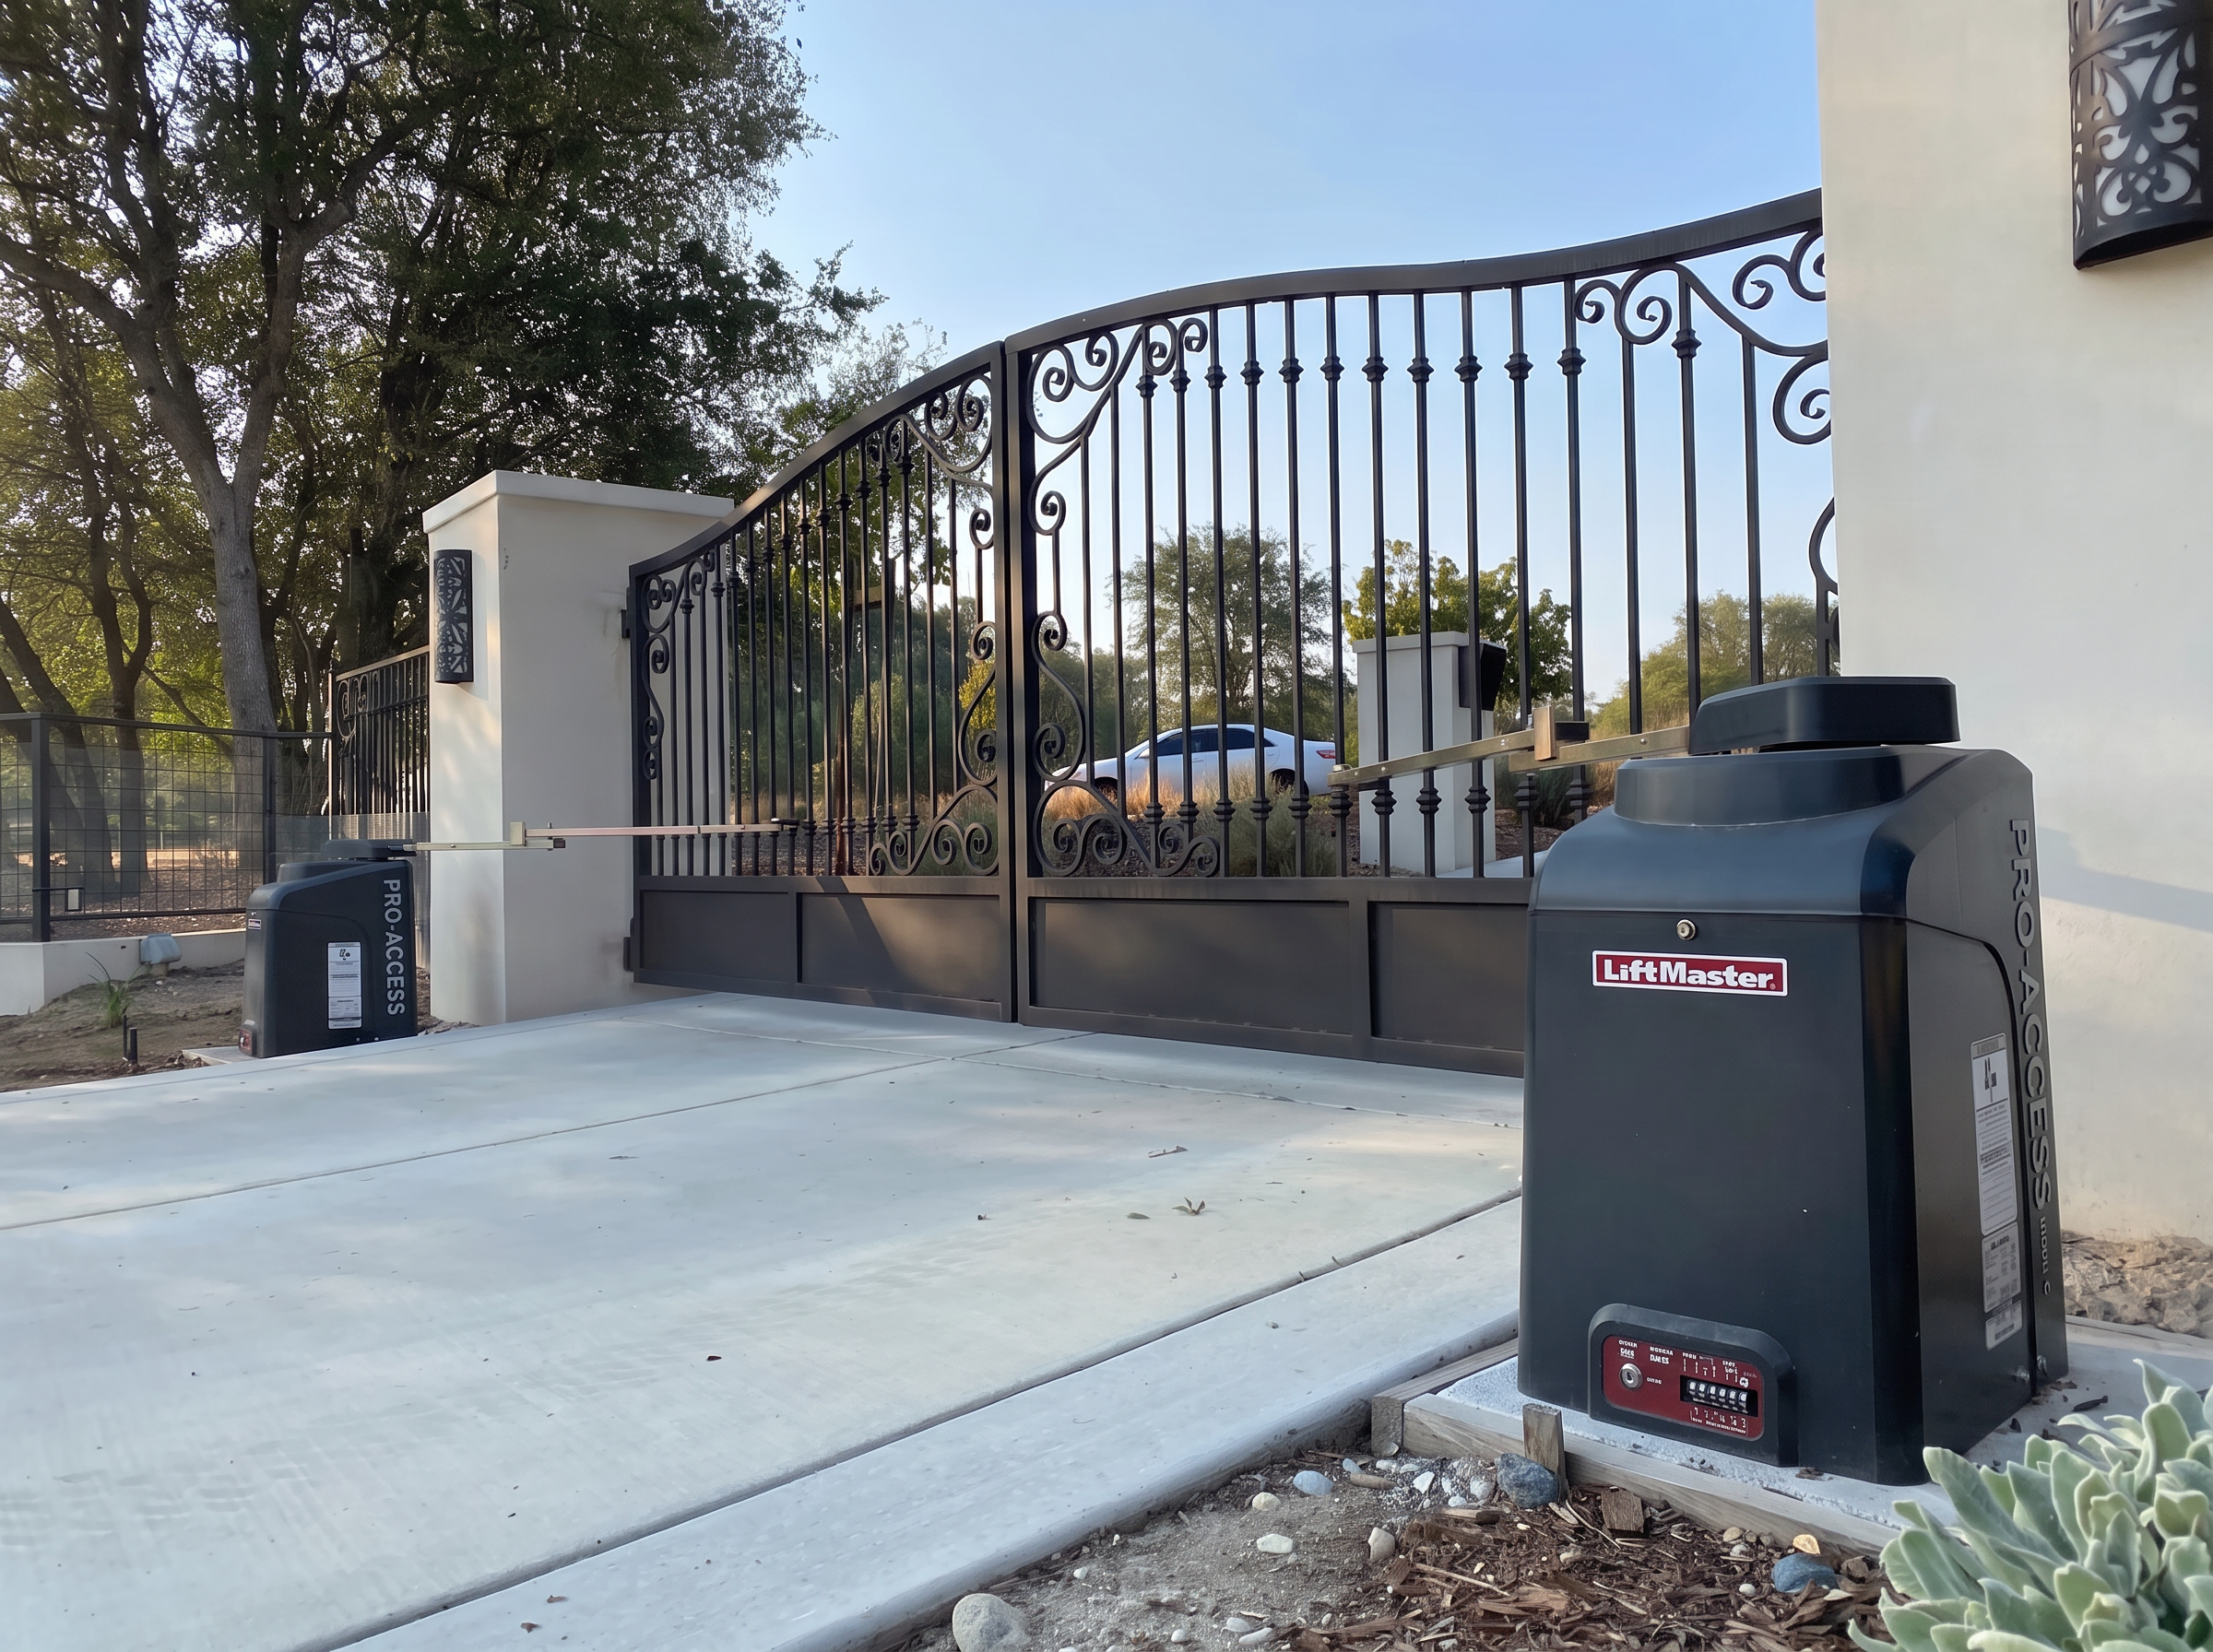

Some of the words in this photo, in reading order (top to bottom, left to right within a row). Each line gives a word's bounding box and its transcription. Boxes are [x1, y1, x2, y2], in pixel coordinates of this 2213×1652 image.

[383, 879, 406, 1016] PRO-ACCESS
[1604, 959, 1774, 989] LiftMaster
[2009, 820, 2052, 1211] PRO-ACCESS
